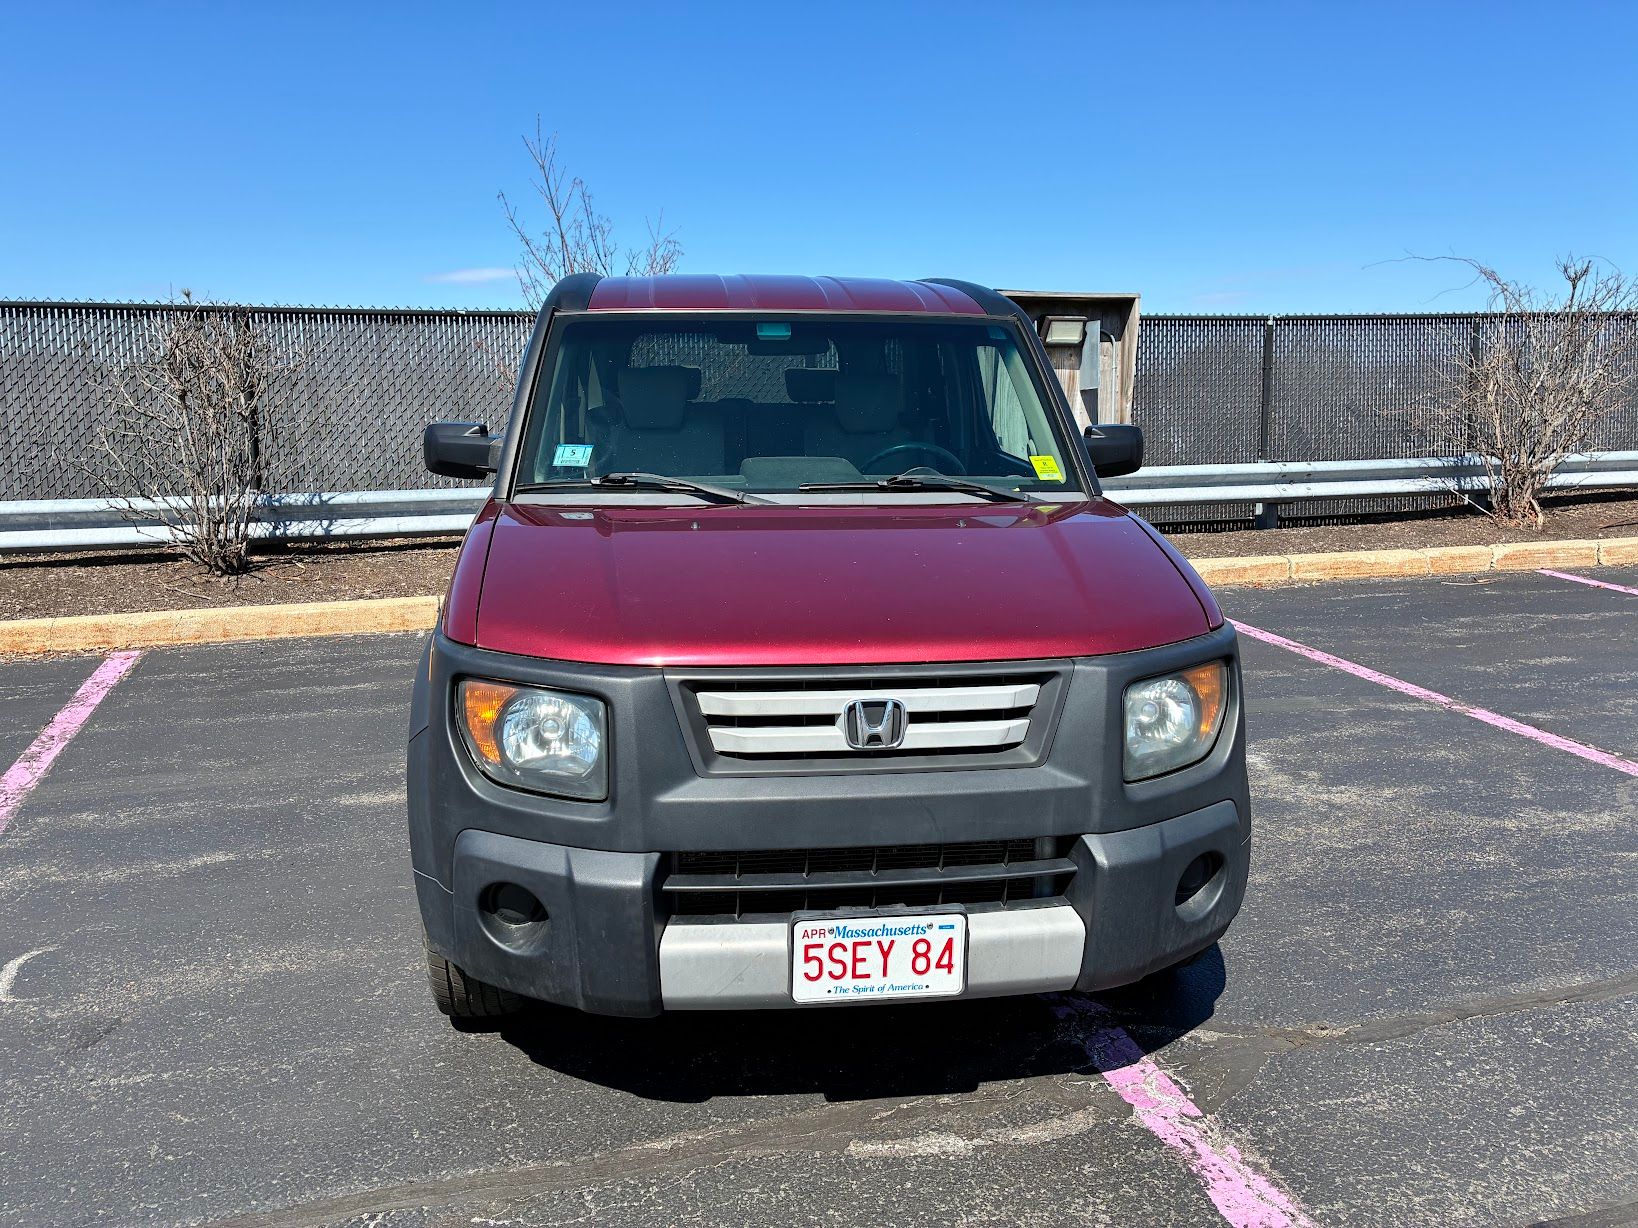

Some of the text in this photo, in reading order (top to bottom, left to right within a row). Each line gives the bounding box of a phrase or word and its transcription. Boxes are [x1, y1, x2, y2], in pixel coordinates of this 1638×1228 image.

[802, 929, 826, 940] APR
[833, 924, 927, 939] Massachusetts
[803, 937, 954, 982] 5SEY 84
[833, 983, 924, 995] The Spirit of America
